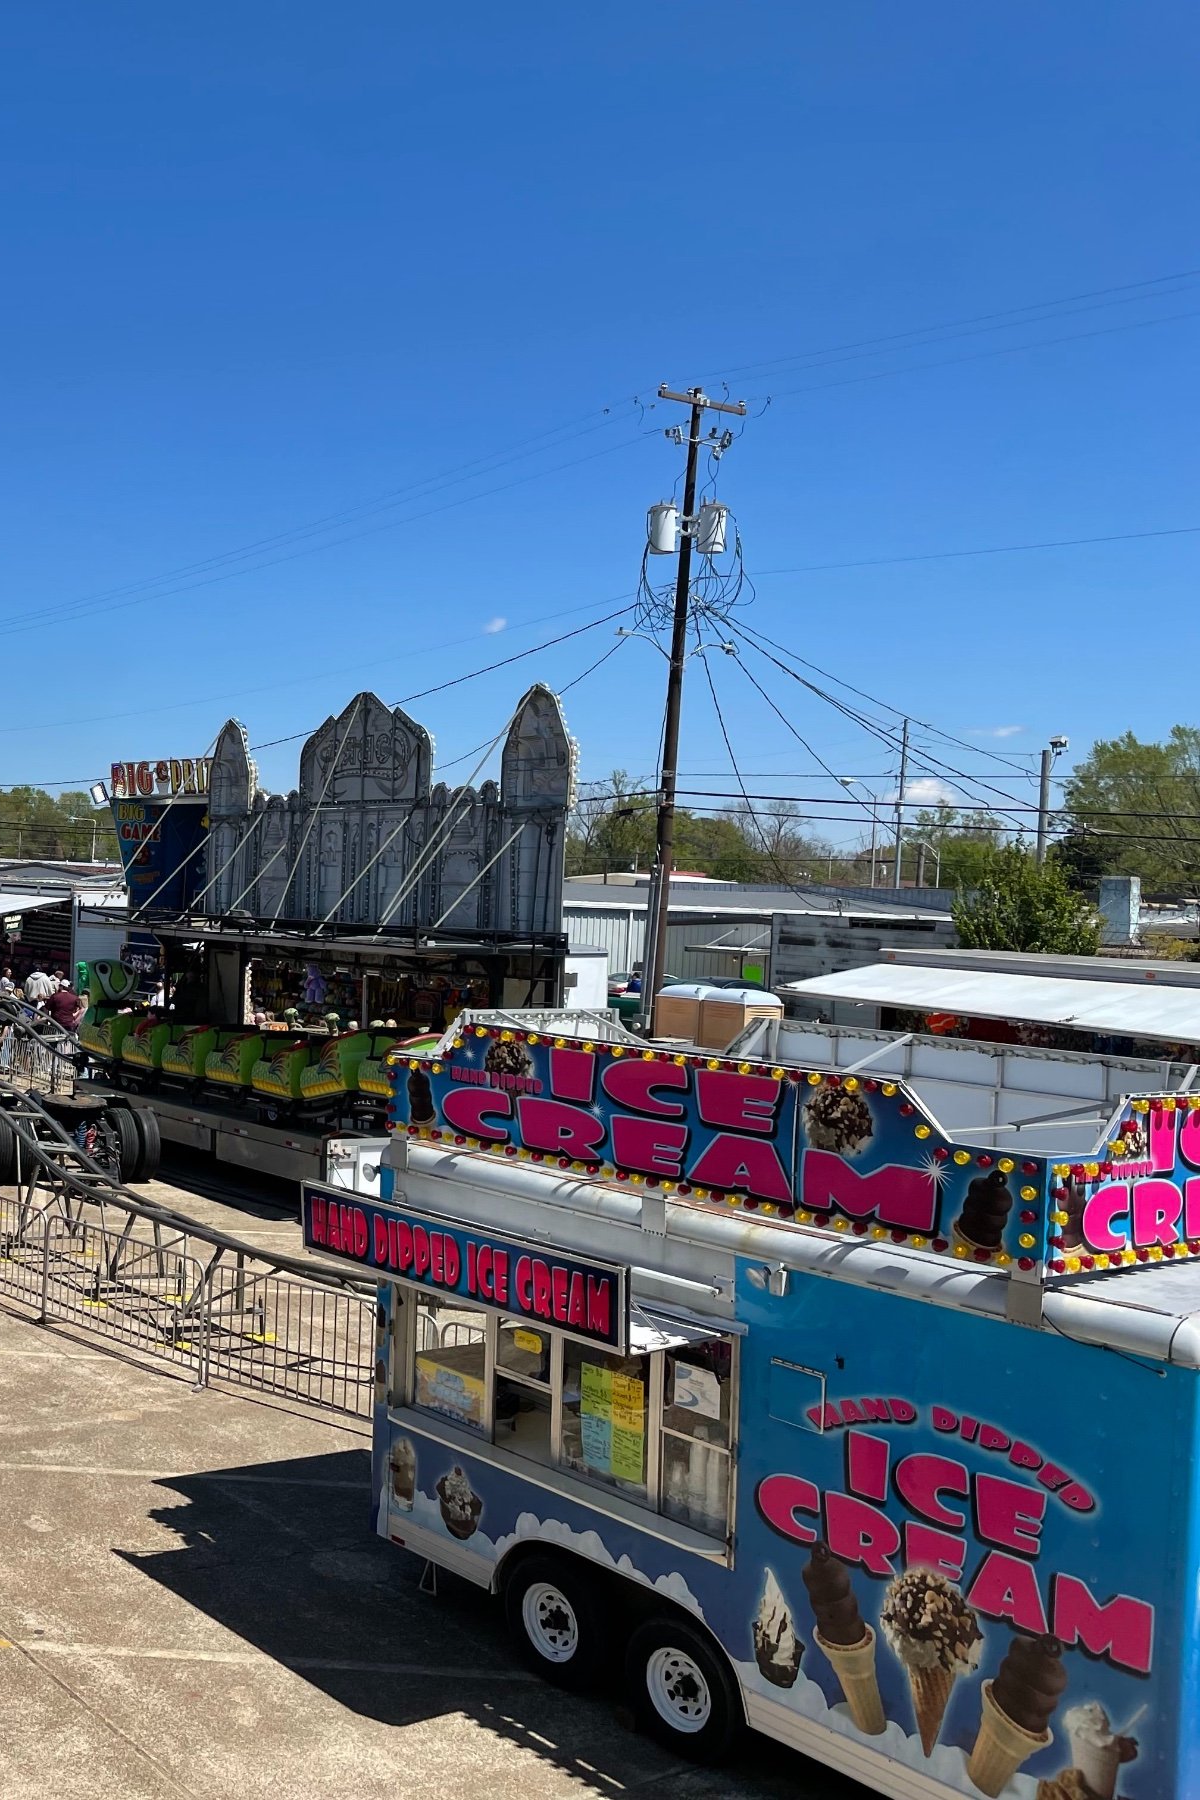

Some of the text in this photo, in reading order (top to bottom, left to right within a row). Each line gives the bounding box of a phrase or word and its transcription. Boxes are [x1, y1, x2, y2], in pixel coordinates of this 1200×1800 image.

[110, 761, 155, 797] BIG
[117, 803, 145, 823] BIG
[120, 822, 162, 843] GAME
[451, 1065, 544, 1095] HAND DIPPED
[549, 1047, 783, 1134] ICE
[441, 1086, 939, 1232] CREAM
[311, 1195, 610, 1336] HAND DIPPED ICE CREAM
[806, 1397, 1094, 1510] HAND DIPPED
[846, 1429, 1048, 1555] ICE
[758, 1473, 1154, 1674] CREAM
